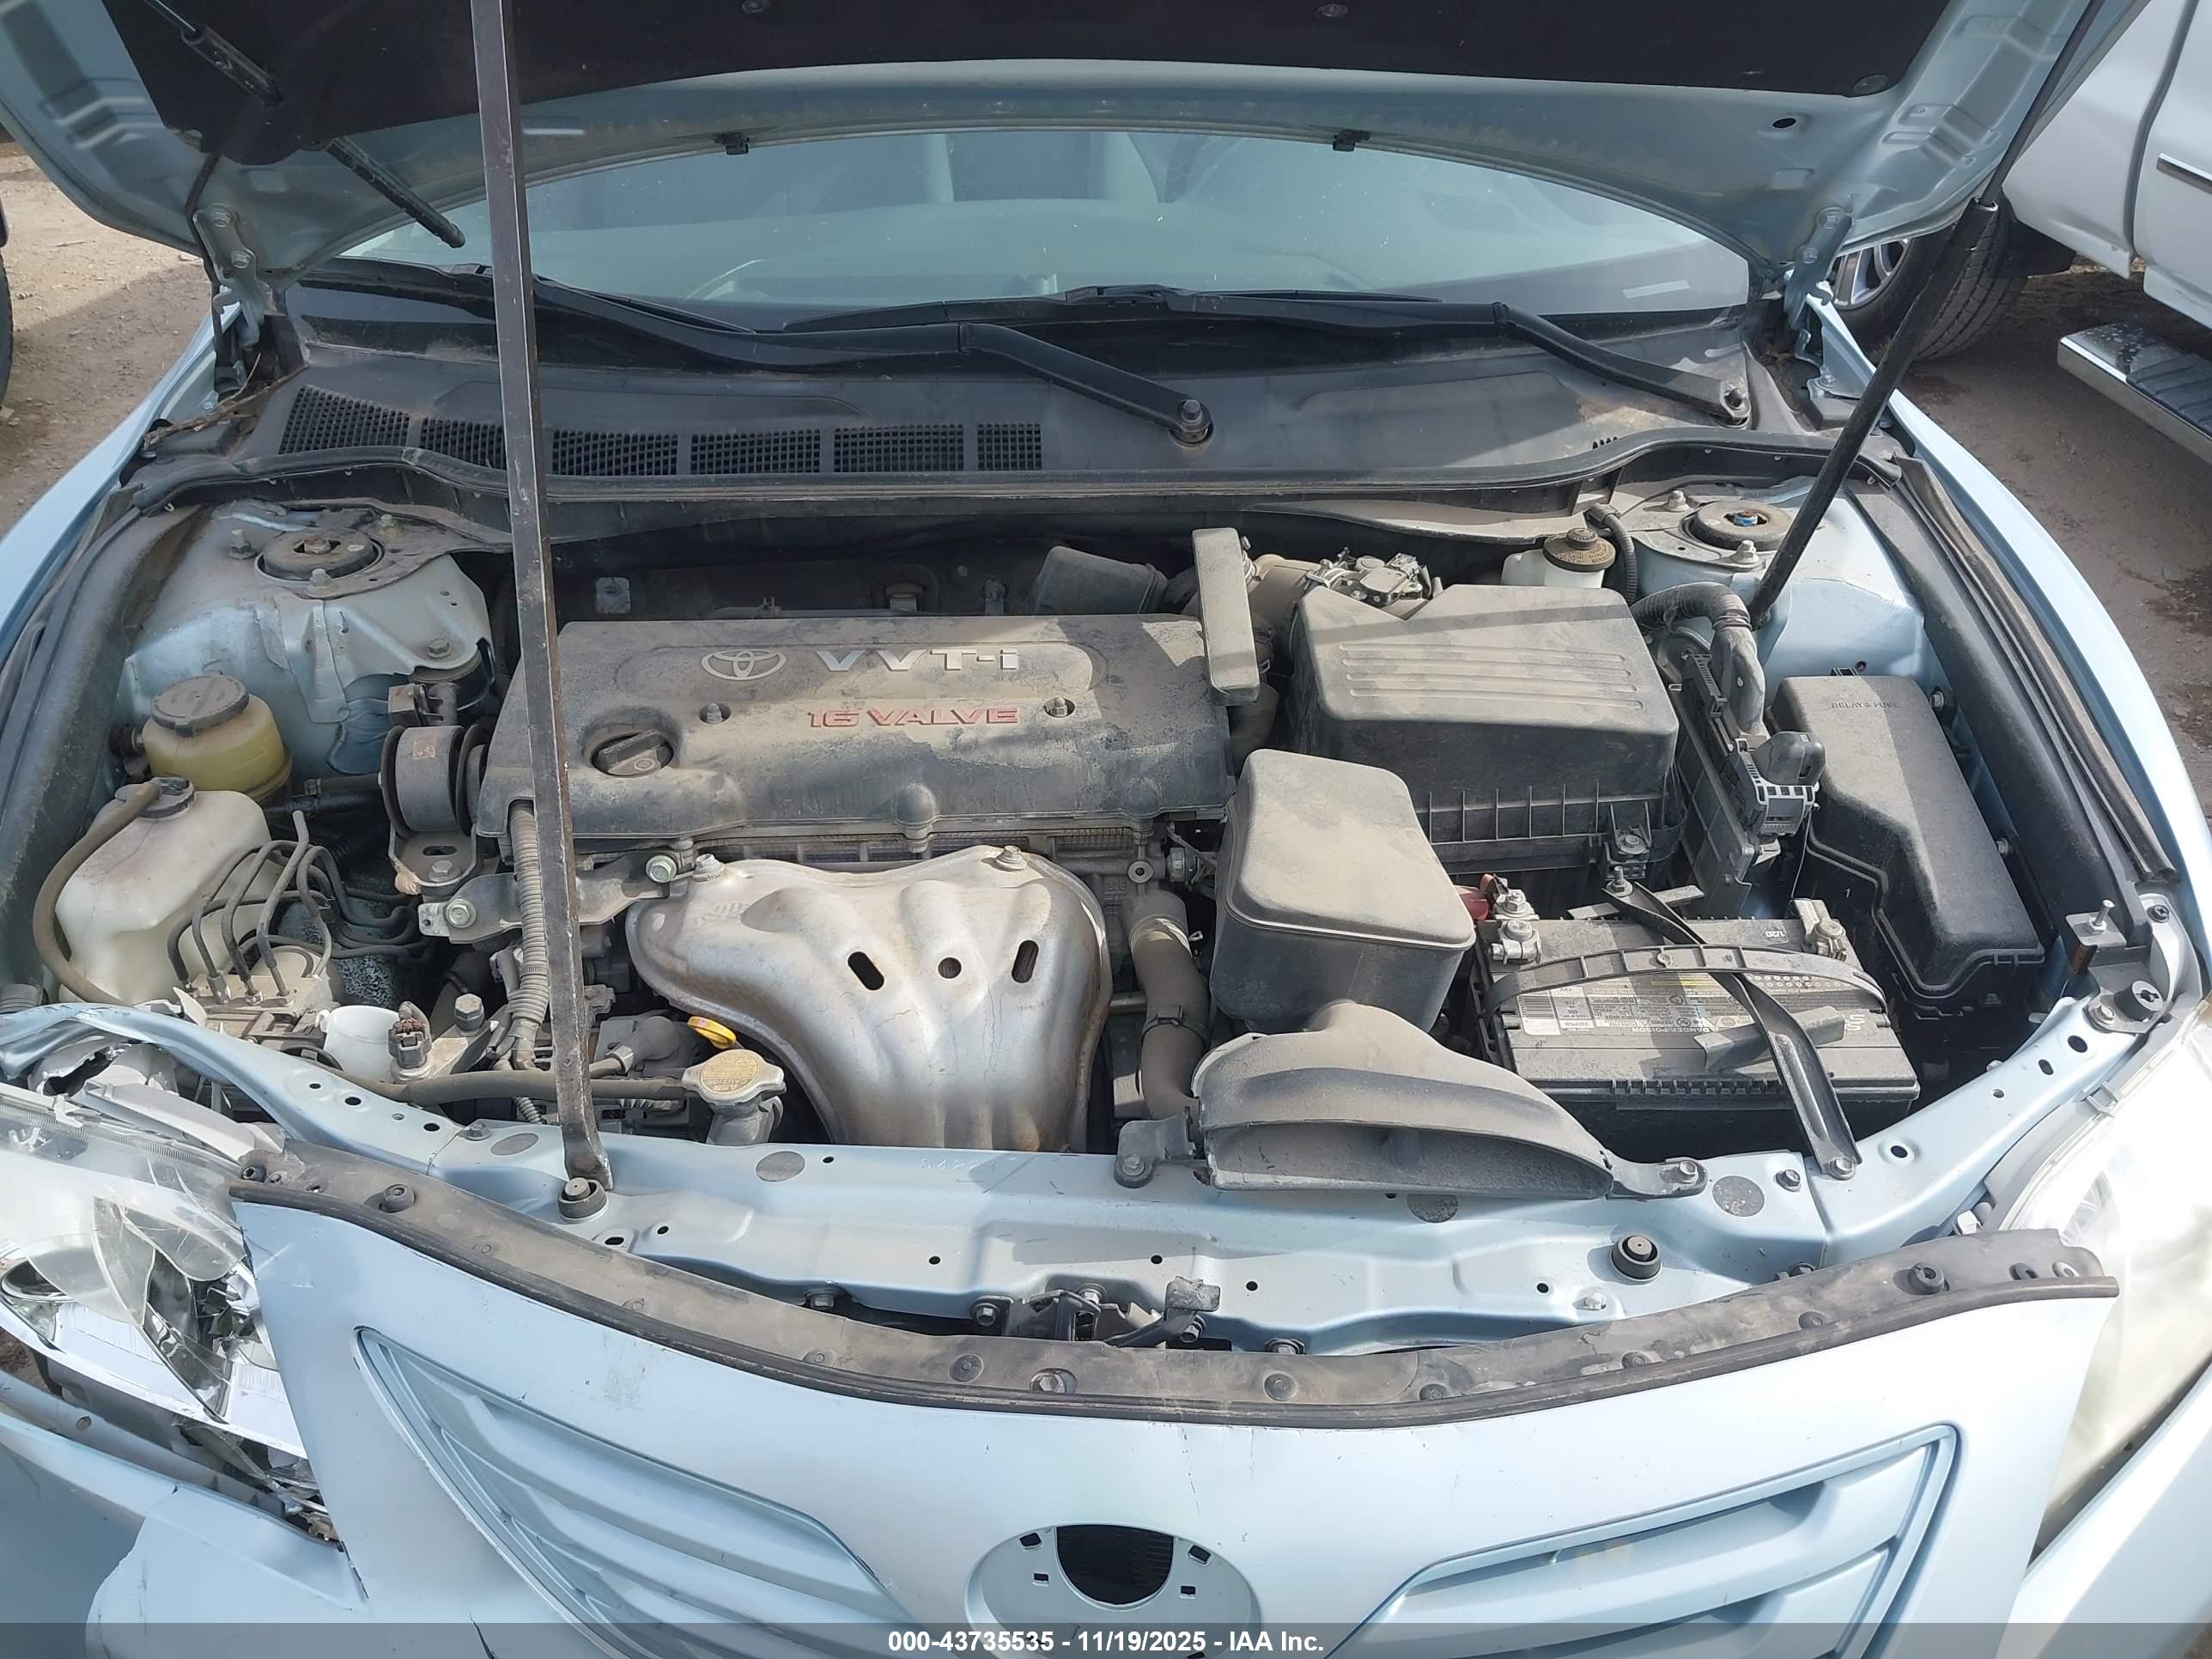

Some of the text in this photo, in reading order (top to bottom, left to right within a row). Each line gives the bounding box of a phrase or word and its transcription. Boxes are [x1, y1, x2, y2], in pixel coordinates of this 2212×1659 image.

[1831, 701, 1863, 709] RELAY
[809, 706, 1019, 728] 16 VALVE
